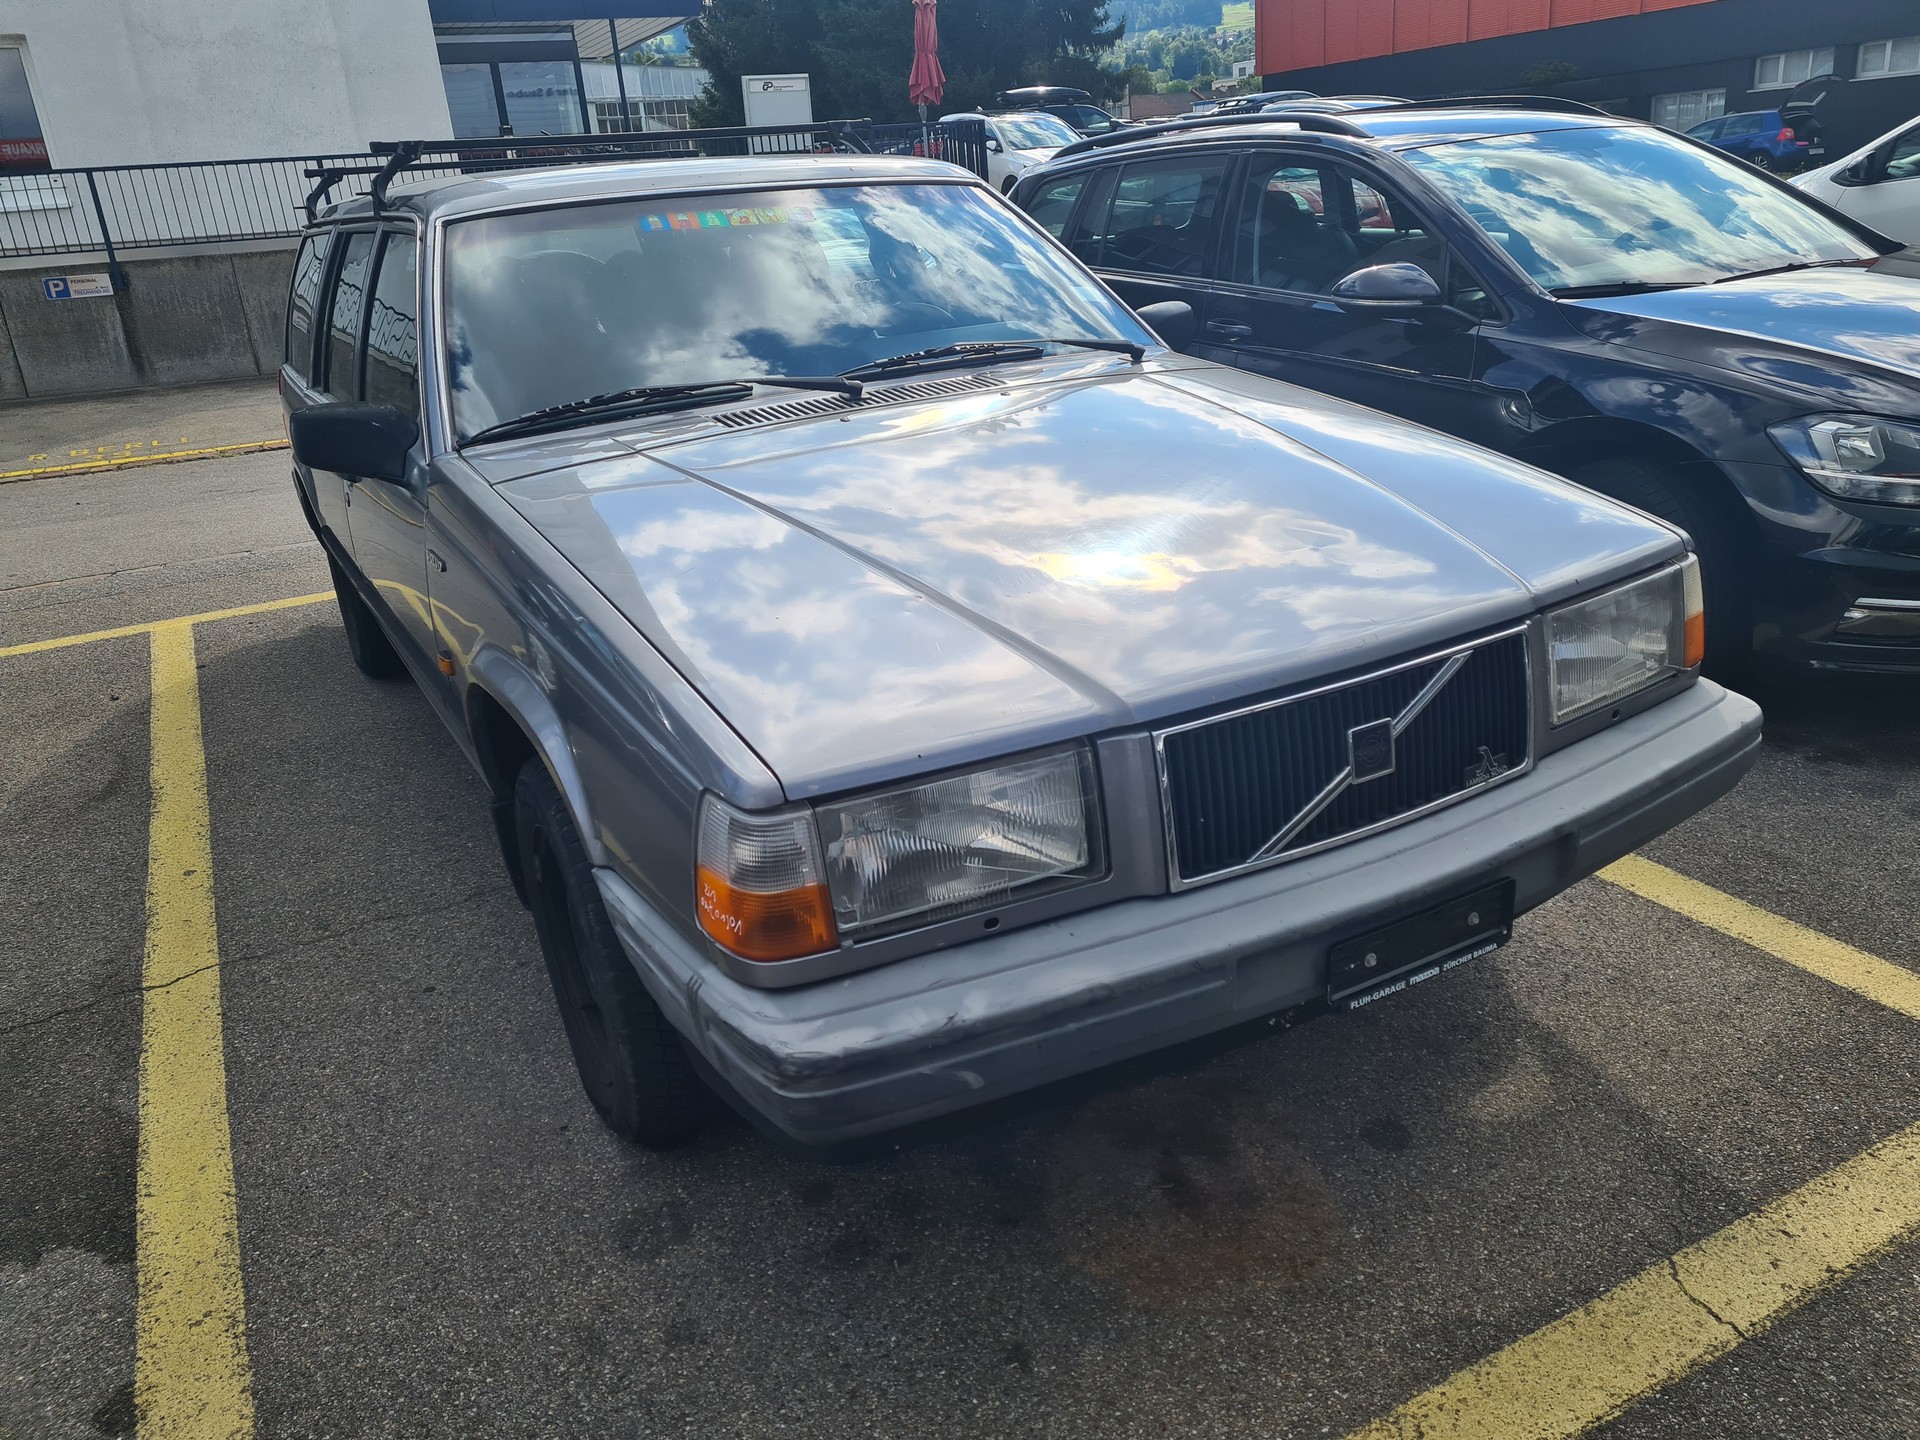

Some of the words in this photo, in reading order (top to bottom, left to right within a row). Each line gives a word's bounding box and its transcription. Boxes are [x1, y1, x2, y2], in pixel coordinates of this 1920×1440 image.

[48, 280, 64, 298] P
[1350, 980, 1407, 1010] FLUH-GARAGE
[1409, 966, 1440, 986] mazda
[1442, 952, 1473, 972] ZÜRCHER
[1473, 942, 1498, 959] BAUMA
